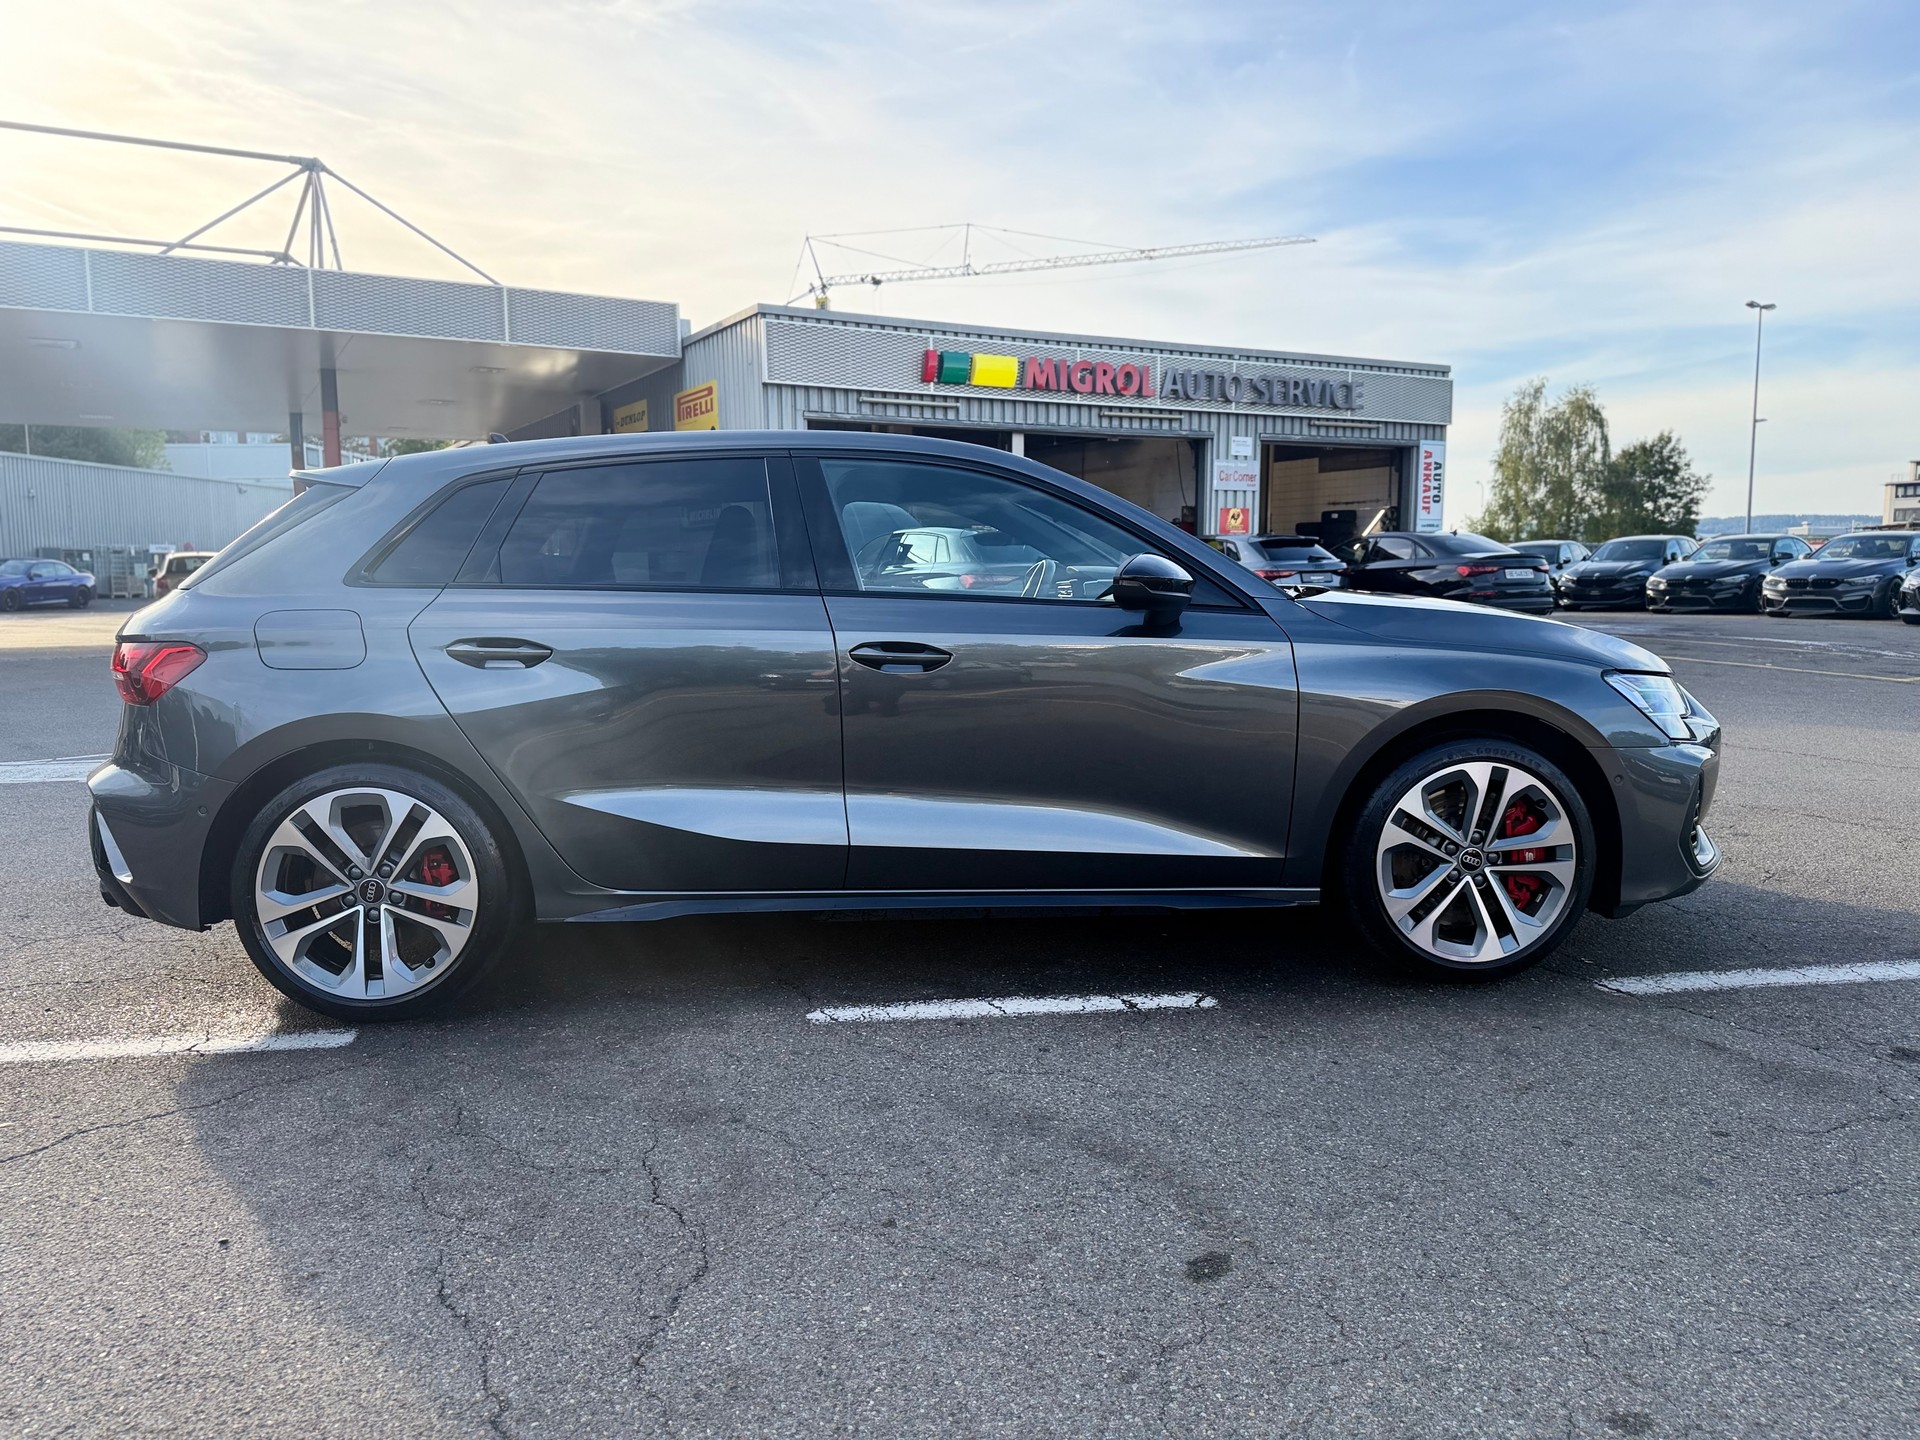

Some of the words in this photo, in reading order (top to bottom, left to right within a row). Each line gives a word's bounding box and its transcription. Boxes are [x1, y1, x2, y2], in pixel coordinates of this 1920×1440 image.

[1024, 356, 1156, 397] MIGROL
[1160, 367, 1245, 404] AUTO
[1251, 373, 1365, 410] SERVICE
[620, 410, 646, 427] DUNLOP
[677, 385, 713, 422] PIRELLI
[1219, 470, 1232, 482] Car
[1233, 470, 1257, 482] Corner
[1421, 449, 1433, 514] ANKAUF
[1432, 460, 1443, 504] AUTO
